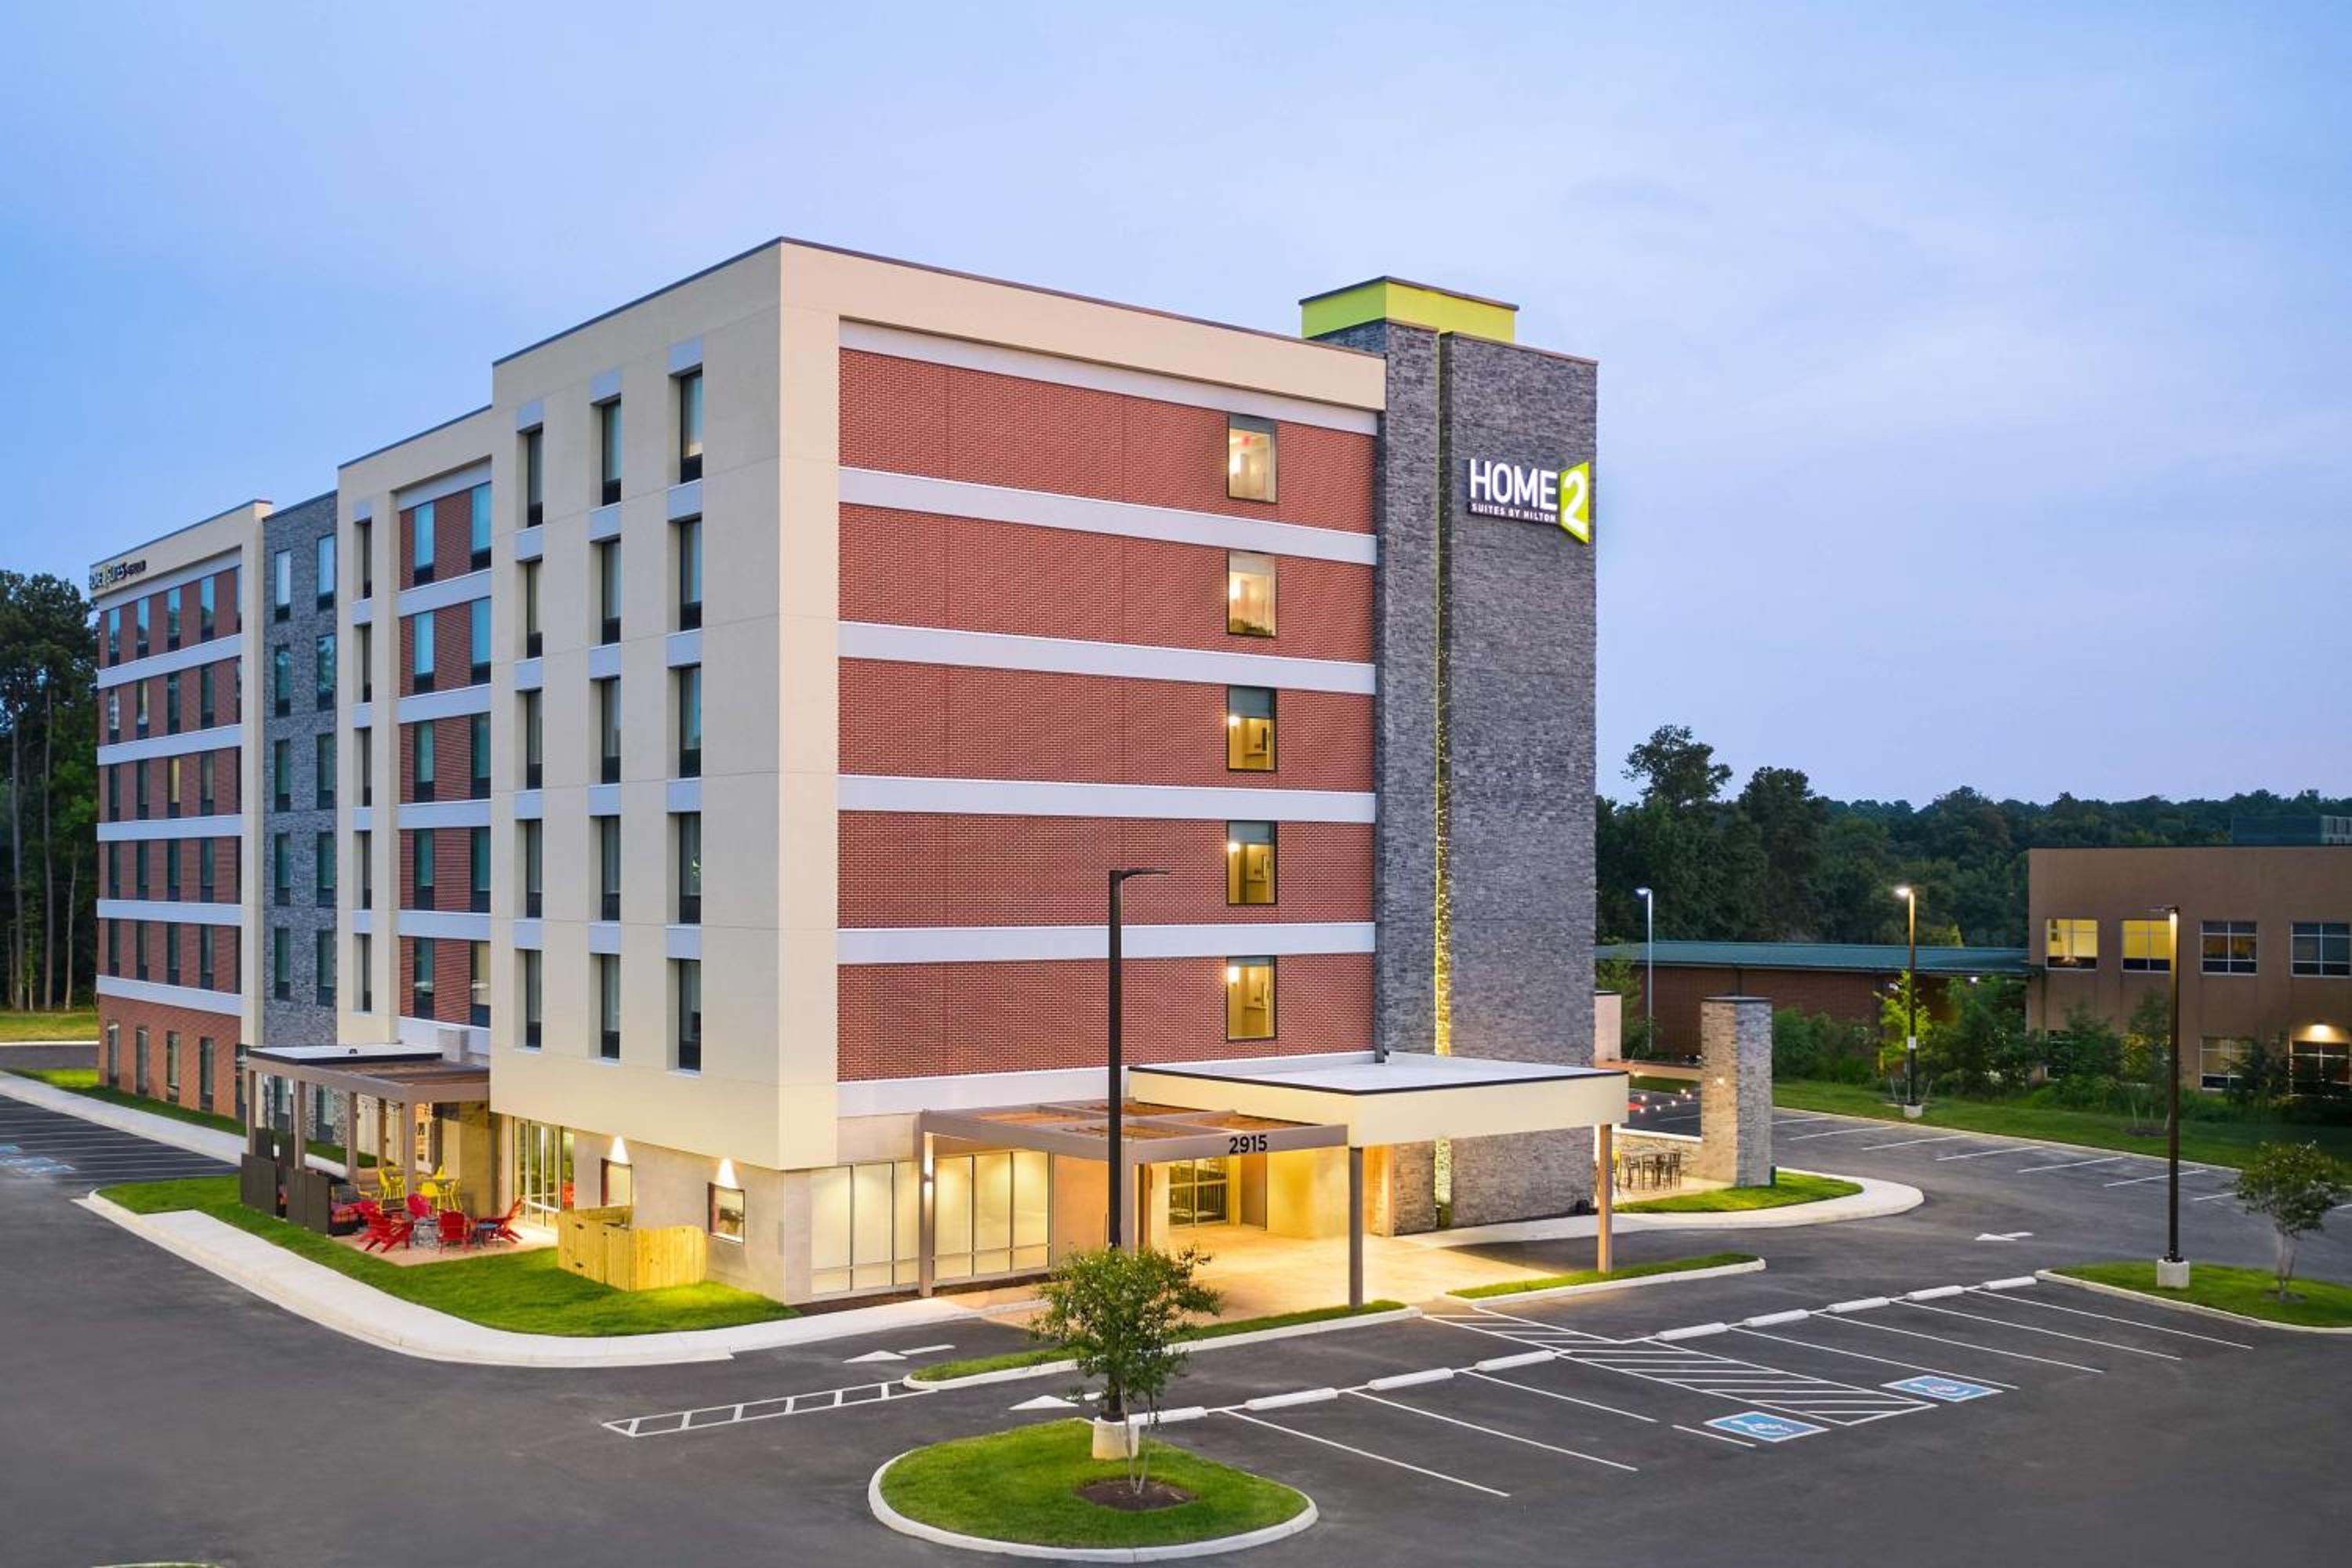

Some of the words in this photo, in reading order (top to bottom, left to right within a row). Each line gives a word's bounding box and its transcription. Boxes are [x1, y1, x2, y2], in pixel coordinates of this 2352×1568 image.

[1471, 503, 1505, 516] SUITES
[1508, 507, 1521, 518] BY
[1523, 510, 1556, 523] HILTON
[1229, 1134, 1268, 1155] 2915
